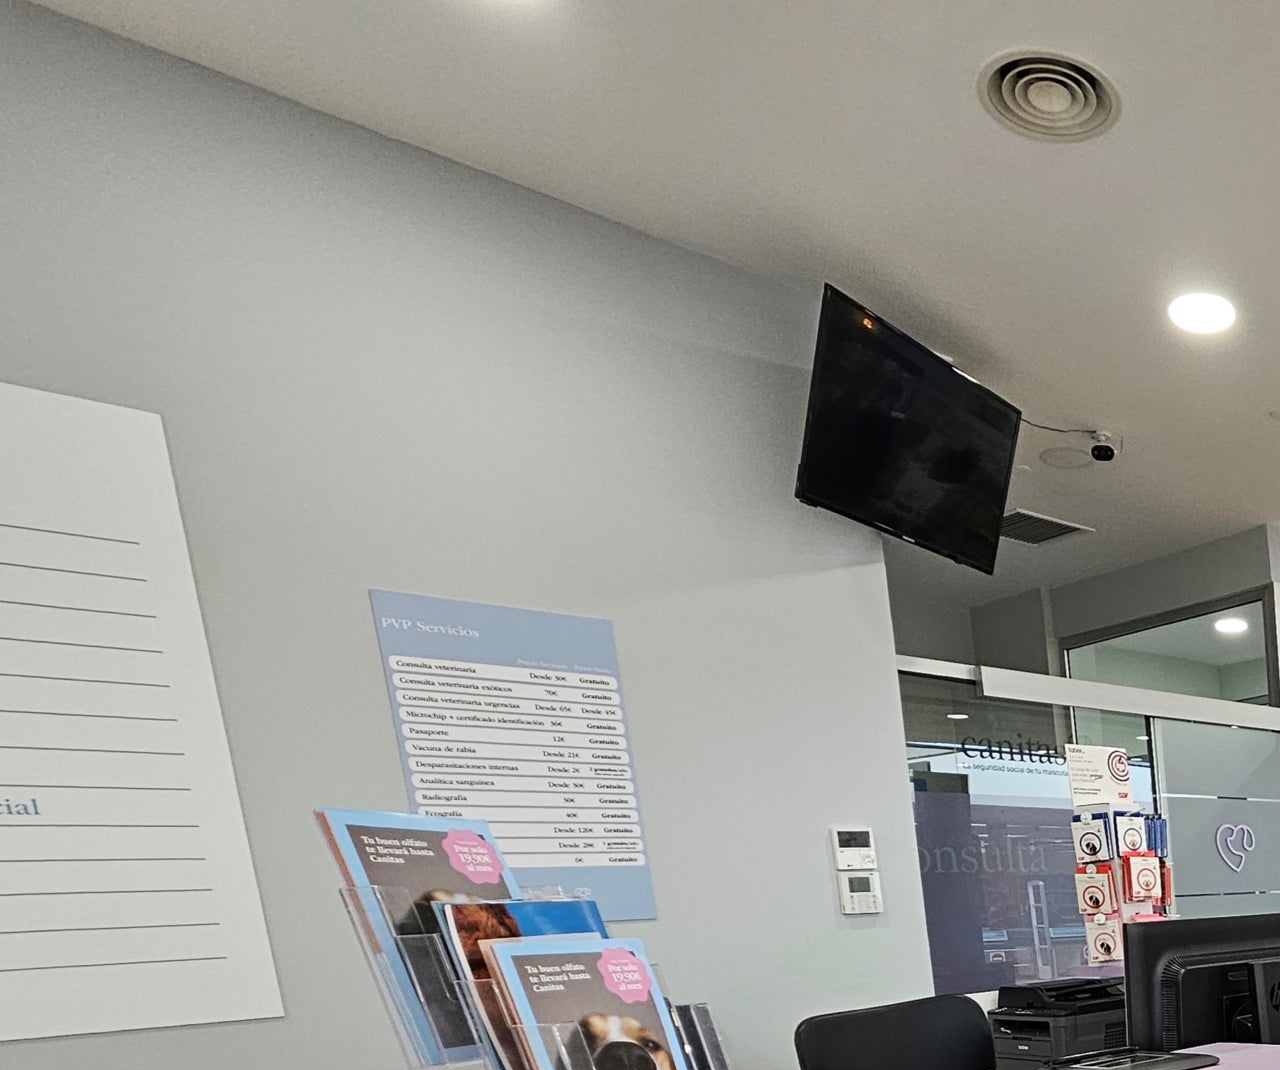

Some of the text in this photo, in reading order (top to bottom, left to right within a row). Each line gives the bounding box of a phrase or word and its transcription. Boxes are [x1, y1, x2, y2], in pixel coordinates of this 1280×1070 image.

[381, 616, 480, 637] PVP Servicios
[396, 660, 477, 673] Consulta veterinaria
[529, 672, 552, 681] Desde
[579, 677, 610, 686] Gratuito
[399, 677, 513, 693] Consulta veterinaria exóticos
[402, 694, 521, 709] Consulta veterinaria urgencias
[582, 693, 612, 701] Gratuito
[535, 704, 557, 712] Desde
[406, 710, 447, 721] Microchip
[456, 715, 496, 723] certificado
[409, 727, 449, 737] Pasaporte
[586, 723, 617, 731] Gratuito
[589, 738, 619, 746] Gratuito
[412, 744, 442, 752] Vacuna
[961, 733, 1067, 766] canitas
[543, 750, 565, 758] Desde
[415, 760, 487, 770] Desparasitaciones
[972, 763, 1006, 772] seguridad
[1006, 765, 1025, 773] social
[548, 781, 570, 789] Desde
[596, 782, 627, 790] Gratuito
[598, 797, 629, 805] Gratuito
[0, 798, 41, 816] ial
[360, 835, 428, 847] Tu buen olfato
[365, 845, 435, 856] te llevará hasta
[370, 854, 406, 864] Canitas
[524, 963, 586, 974] Tu buen olfato
[607, 963, 622, 972] Por
[529, 972, 591, 983] te llevará hasta
[532, 983, 565, 993] Canitas
